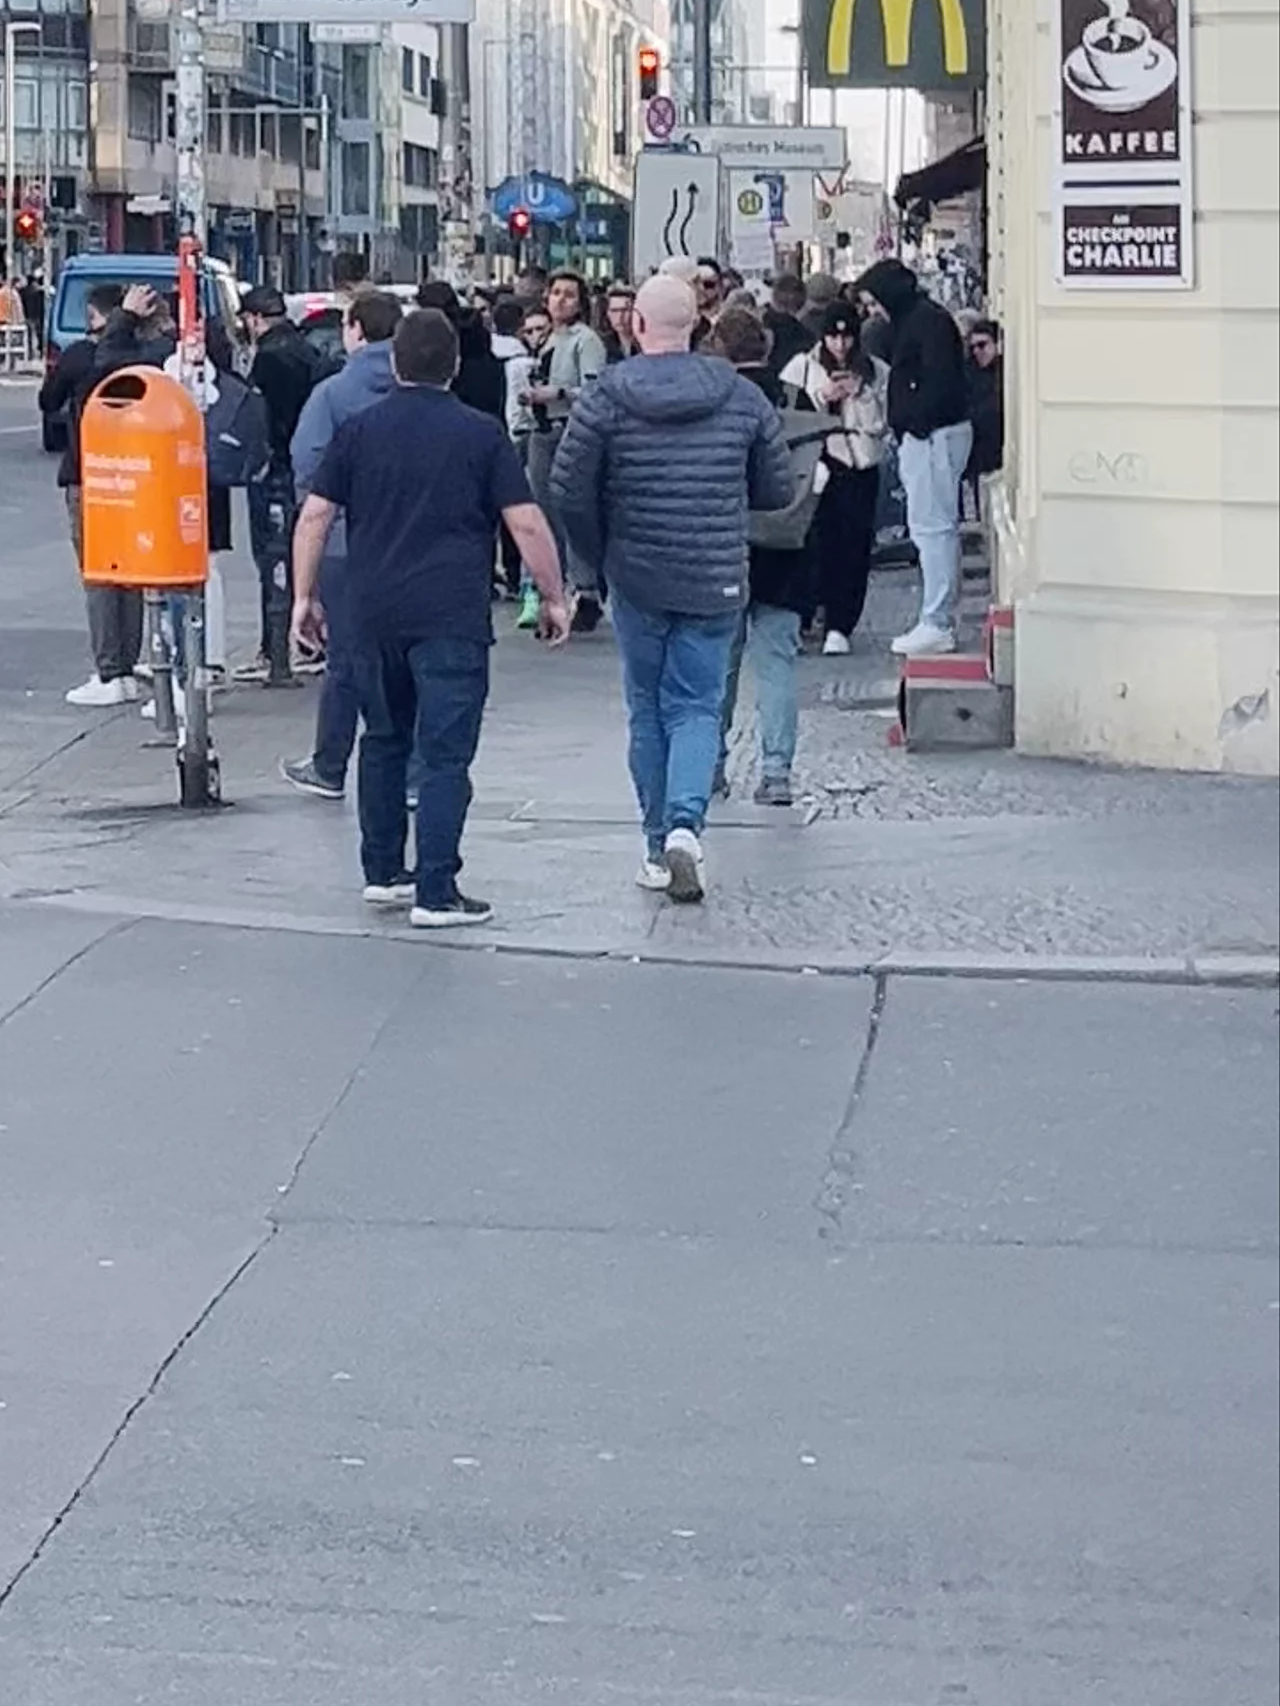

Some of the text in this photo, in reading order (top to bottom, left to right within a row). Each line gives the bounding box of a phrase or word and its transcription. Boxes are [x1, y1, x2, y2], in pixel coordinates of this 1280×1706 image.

[1065, 131, 1176, 154] KAFFEE
[1066, 226, 1177, 243] CHECKPOINT
[1066, 244, 1177, 267] CHARLIE
